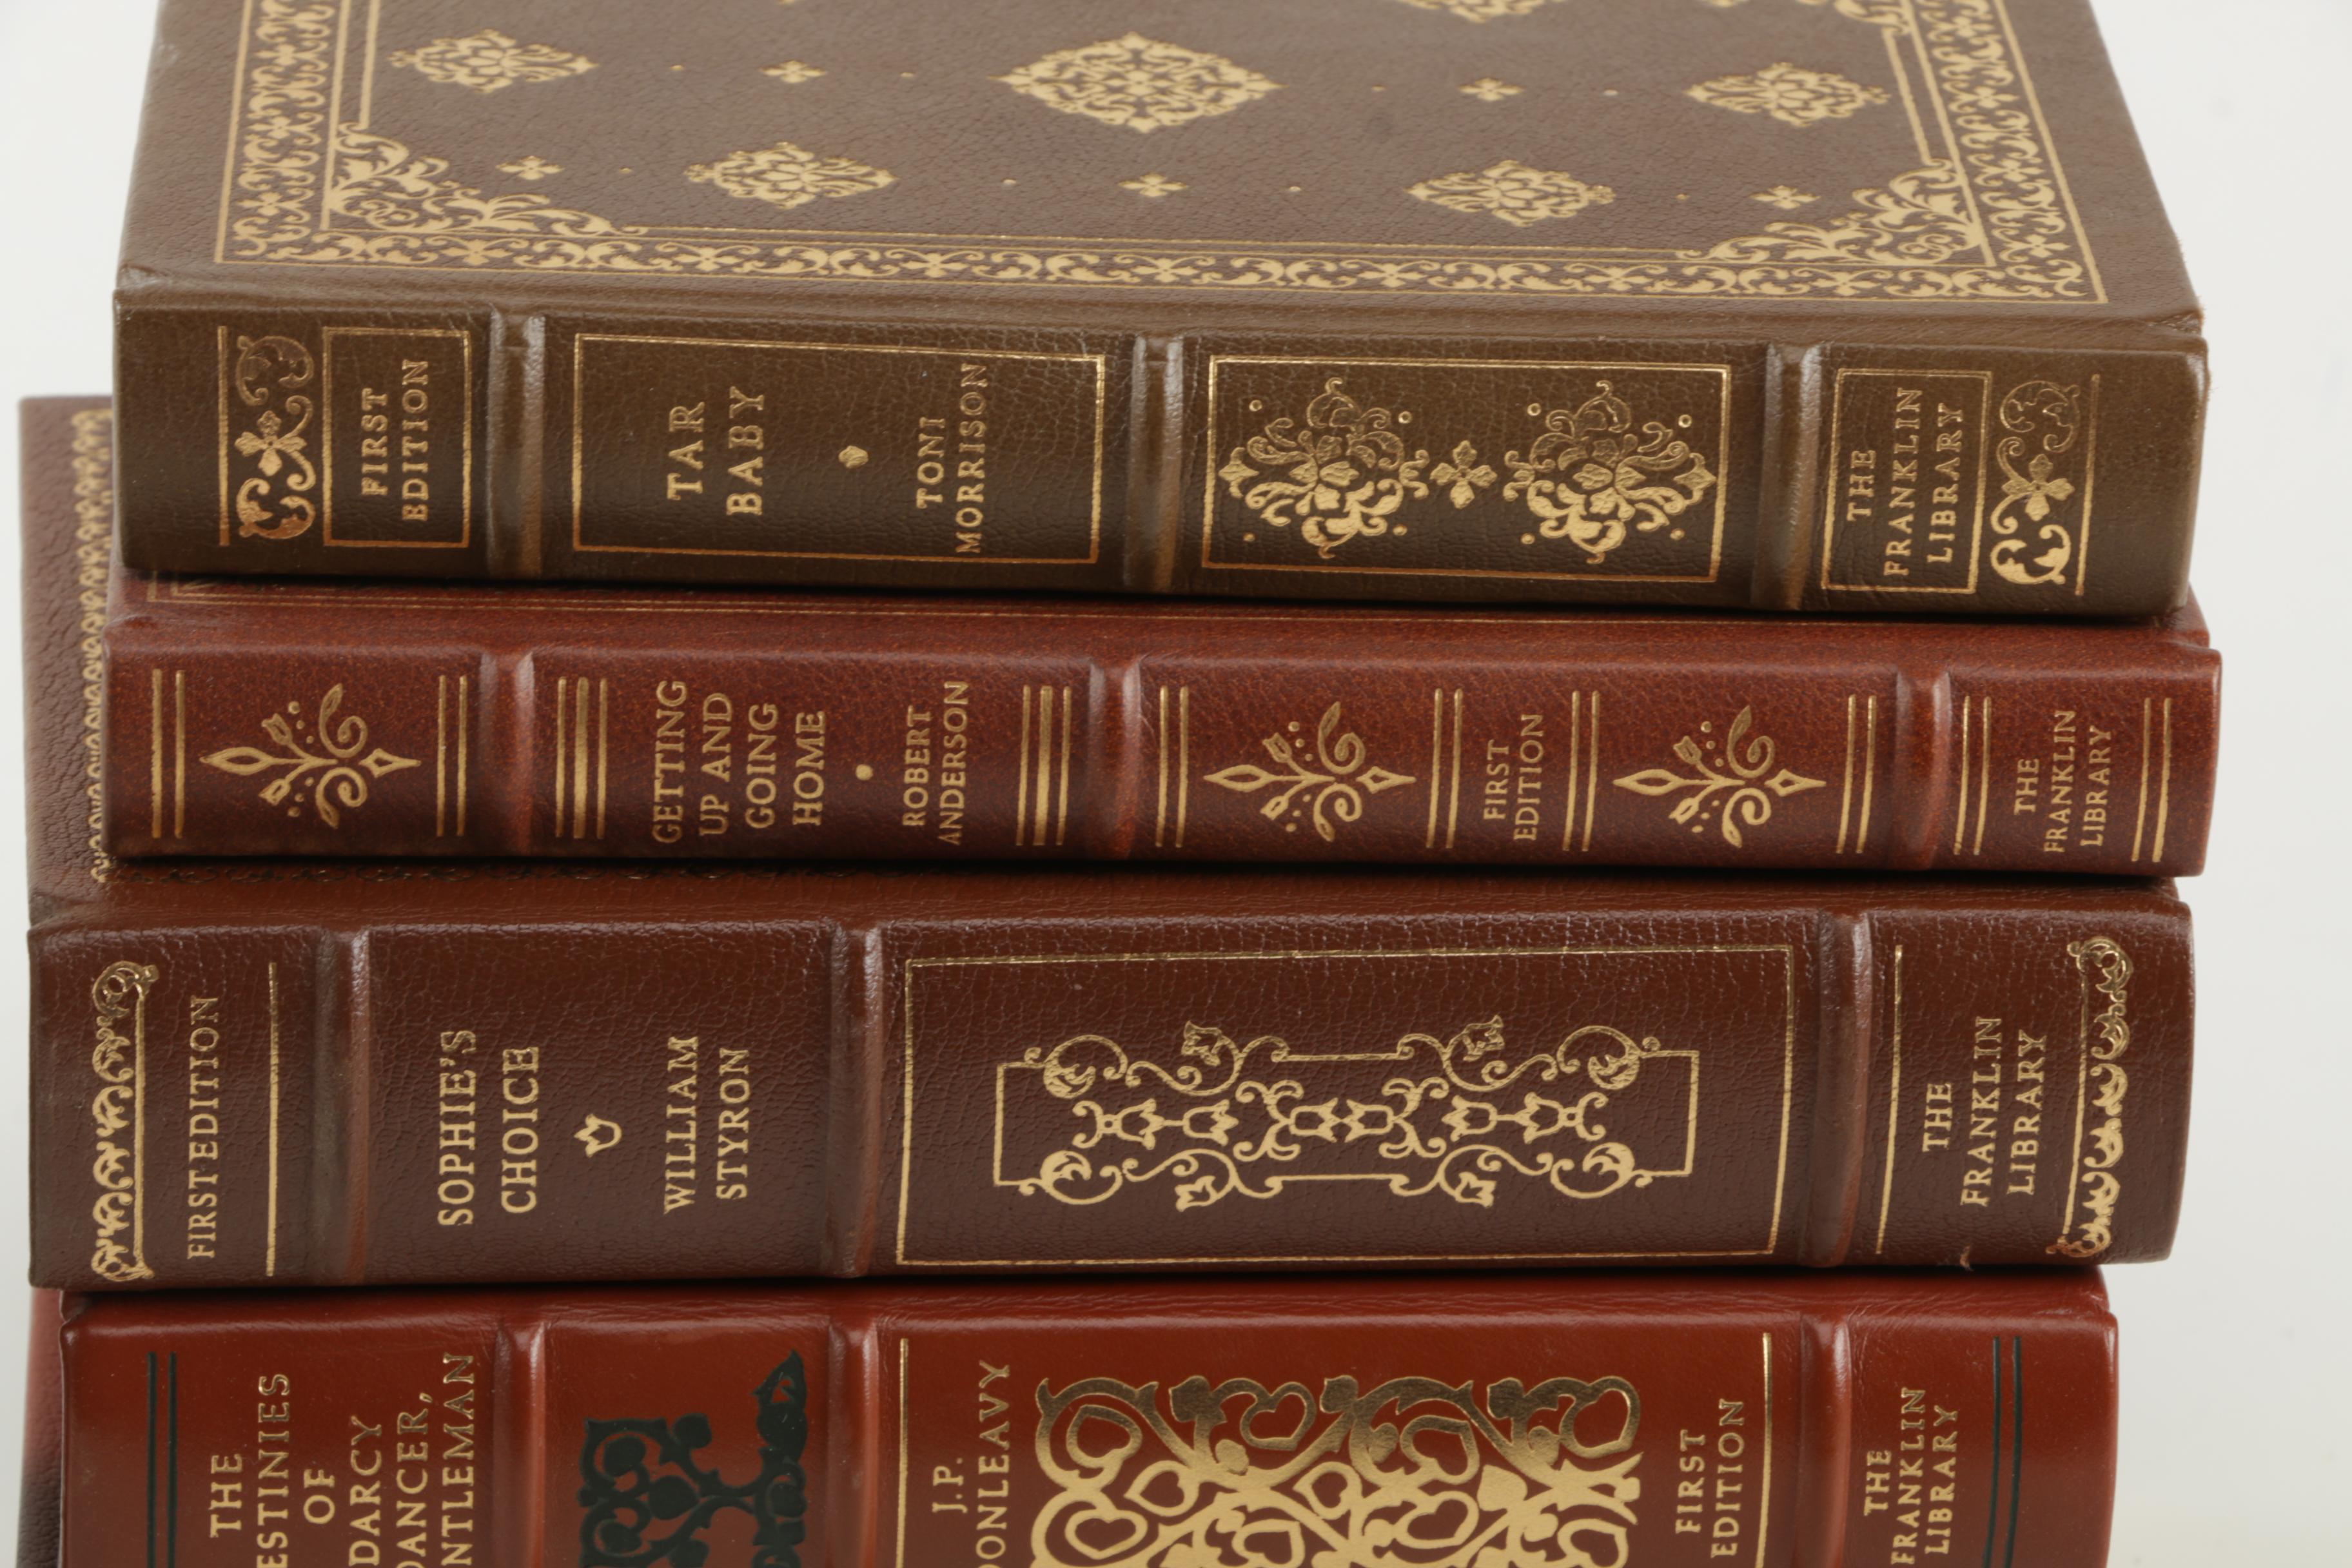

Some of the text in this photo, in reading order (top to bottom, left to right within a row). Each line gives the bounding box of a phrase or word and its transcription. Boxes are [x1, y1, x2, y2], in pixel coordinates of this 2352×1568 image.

[360, 387, 387, 495] FIRST
[666, 401, 705, 501] TAR
[726, 386, 764, 516] BABY
[916, 416, 945, 509] TONI
[955, 362, 988, 553] MORRISON
[1845, 449, 1876, 522] THE
[1883, 387, 1923, 576] FRANKLIN
[1926, 402, 1963, 564] LIBRARY
[652, 680, 687, 843] GETTING
[700, 692, 733, 836] UP AND
[745, 703, 778, 829] GOING
[792, 710, 825, 827] HOME
[902, 704, 930, 827] ROBERT
[938, 681, 969, 845] ANDERSON
[1483, 739, 1510, 819] FIRST
[1513, 713, 1545, 841] EDITION
[2013, 758, 2039, 816] THE
[2043, 709, 2076, 853] FRANKLIN
[2079, 725, 2112, 847] LIBRARY
[187, 995, 220, 1260] FIRST EDITION
[437, 1030, 476, 1226] SOPHIE'S
[500, 1046, 540, 1214] CHOICE
[663, 1035, 698, 1215] WILLIAM
[716, 1047, 751, 1199] STYRON
[1921, 1083, 1953, 1153] THE
[1960, 1015, 2003, 1207] FRANKLIN
[2006, 1029, 2047, 1195] LIBRARY
[208, 1453, 242, 1538] THE
[302, 1469, 336, 1525] OF
[348, 1415, 382, 1567] DARCY
[395, 1392, 433, 1568] ANCER,
[932, 1458, 968, 1514] J.P.
[975, 1360, 1010, 1568] ONLEAVY
[1675, 1429, 1705, 1534] FIRST
[1710, 1397, 1745, 1558] EDITION
[1863, 1449, 1892, 1516] THE
[1888, 1386, 1926, 1565] FRANKLIN
[1924, 1404, 1958, 1554] LIBRARY
